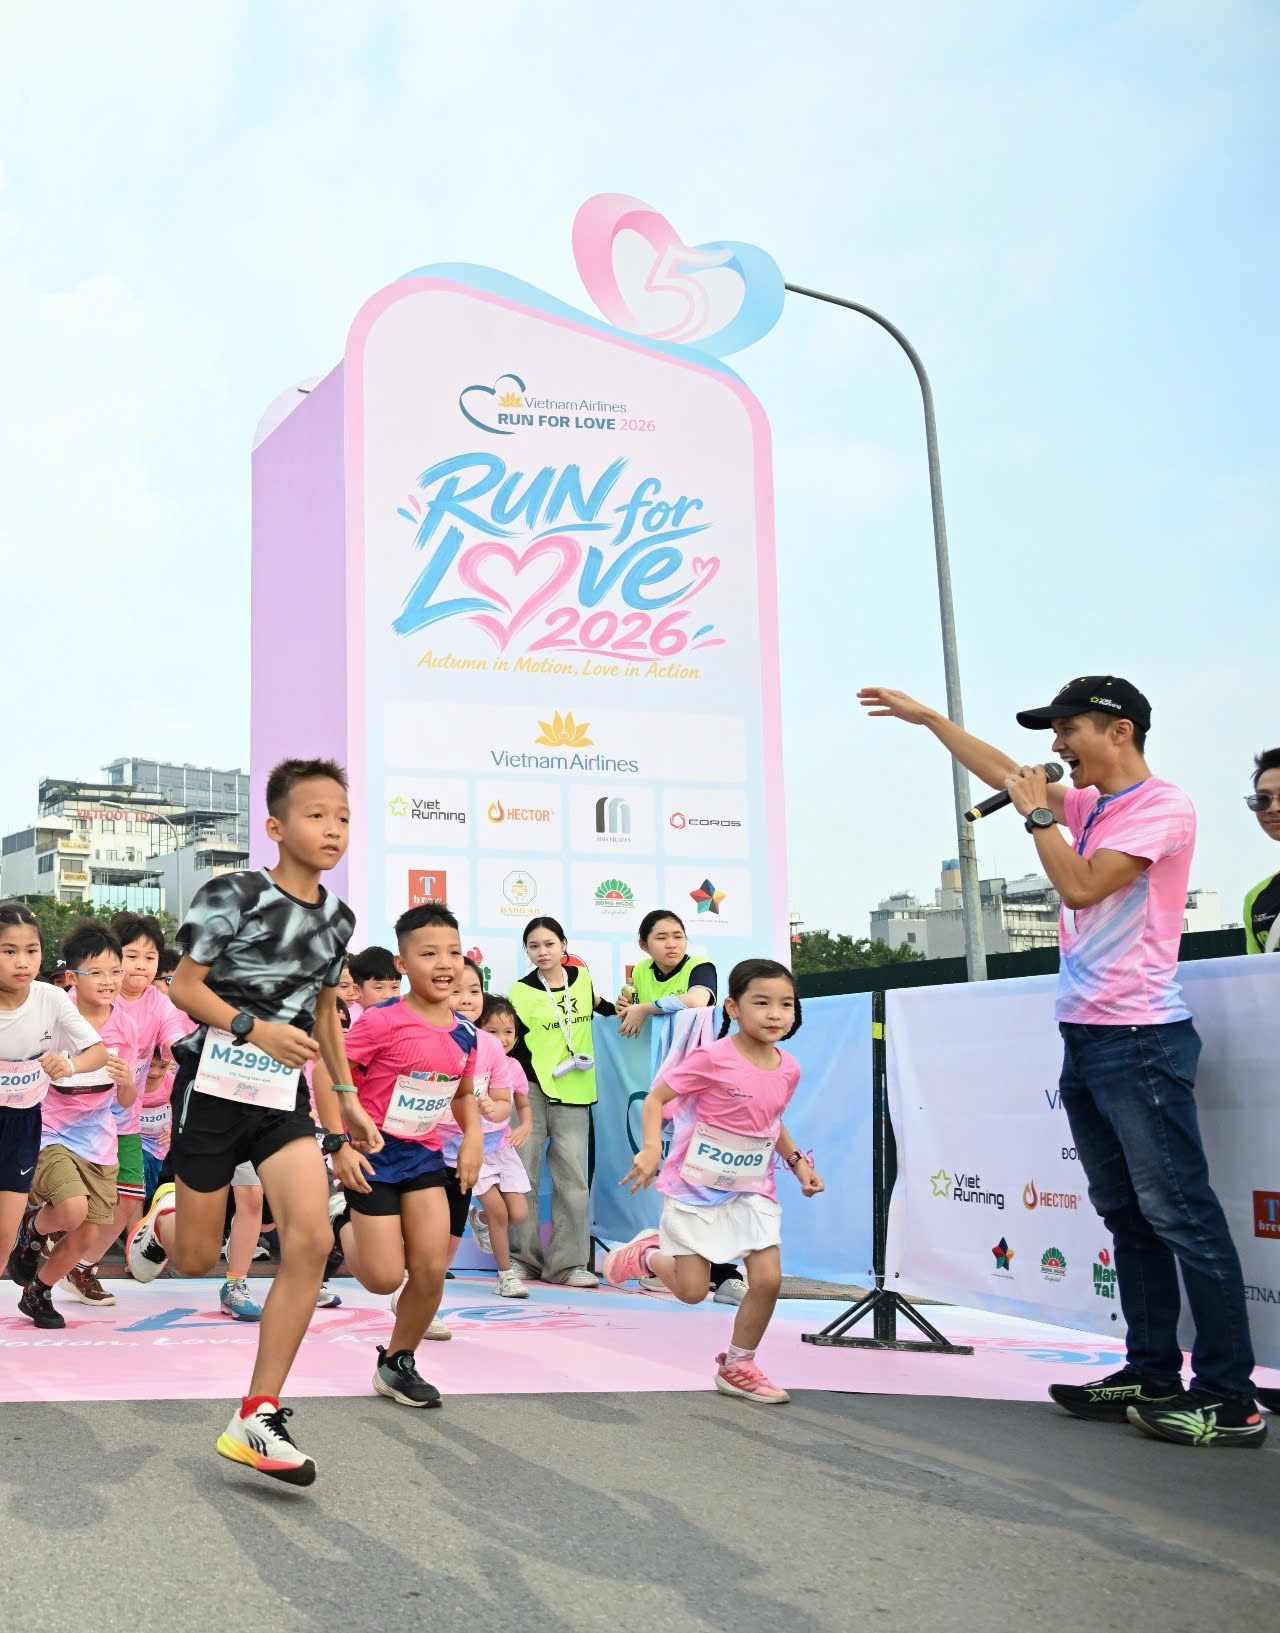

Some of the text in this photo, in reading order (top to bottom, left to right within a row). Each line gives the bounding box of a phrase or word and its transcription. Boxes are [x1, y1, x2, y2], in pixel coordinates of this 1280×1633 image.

[524, 396, 627, 414] Vietnam Airlines
[497, 412, 656, 433] RUN FOR LOVE 2026
[415, 451, 704, 552] RUN for
[526, 606, 694, 658] 2026
[417, 649, 701, 679] Autumn in Motion, Love in Action
[490, 750, 639, 773] Vietnam Airlines
[412, 799, 441, 810] Viet
[411, 809, 466, 823] Running
[507, 808, 550, 822] HECTOR
[419, 876, 436, 896] T
[697, 1142, 764, 1167] F20009
[954, 1173, 981, 1189] Viet
[953, 1188, 1005, 1210] Running
[1040, 1191, 1078, 1209] HECTOR
